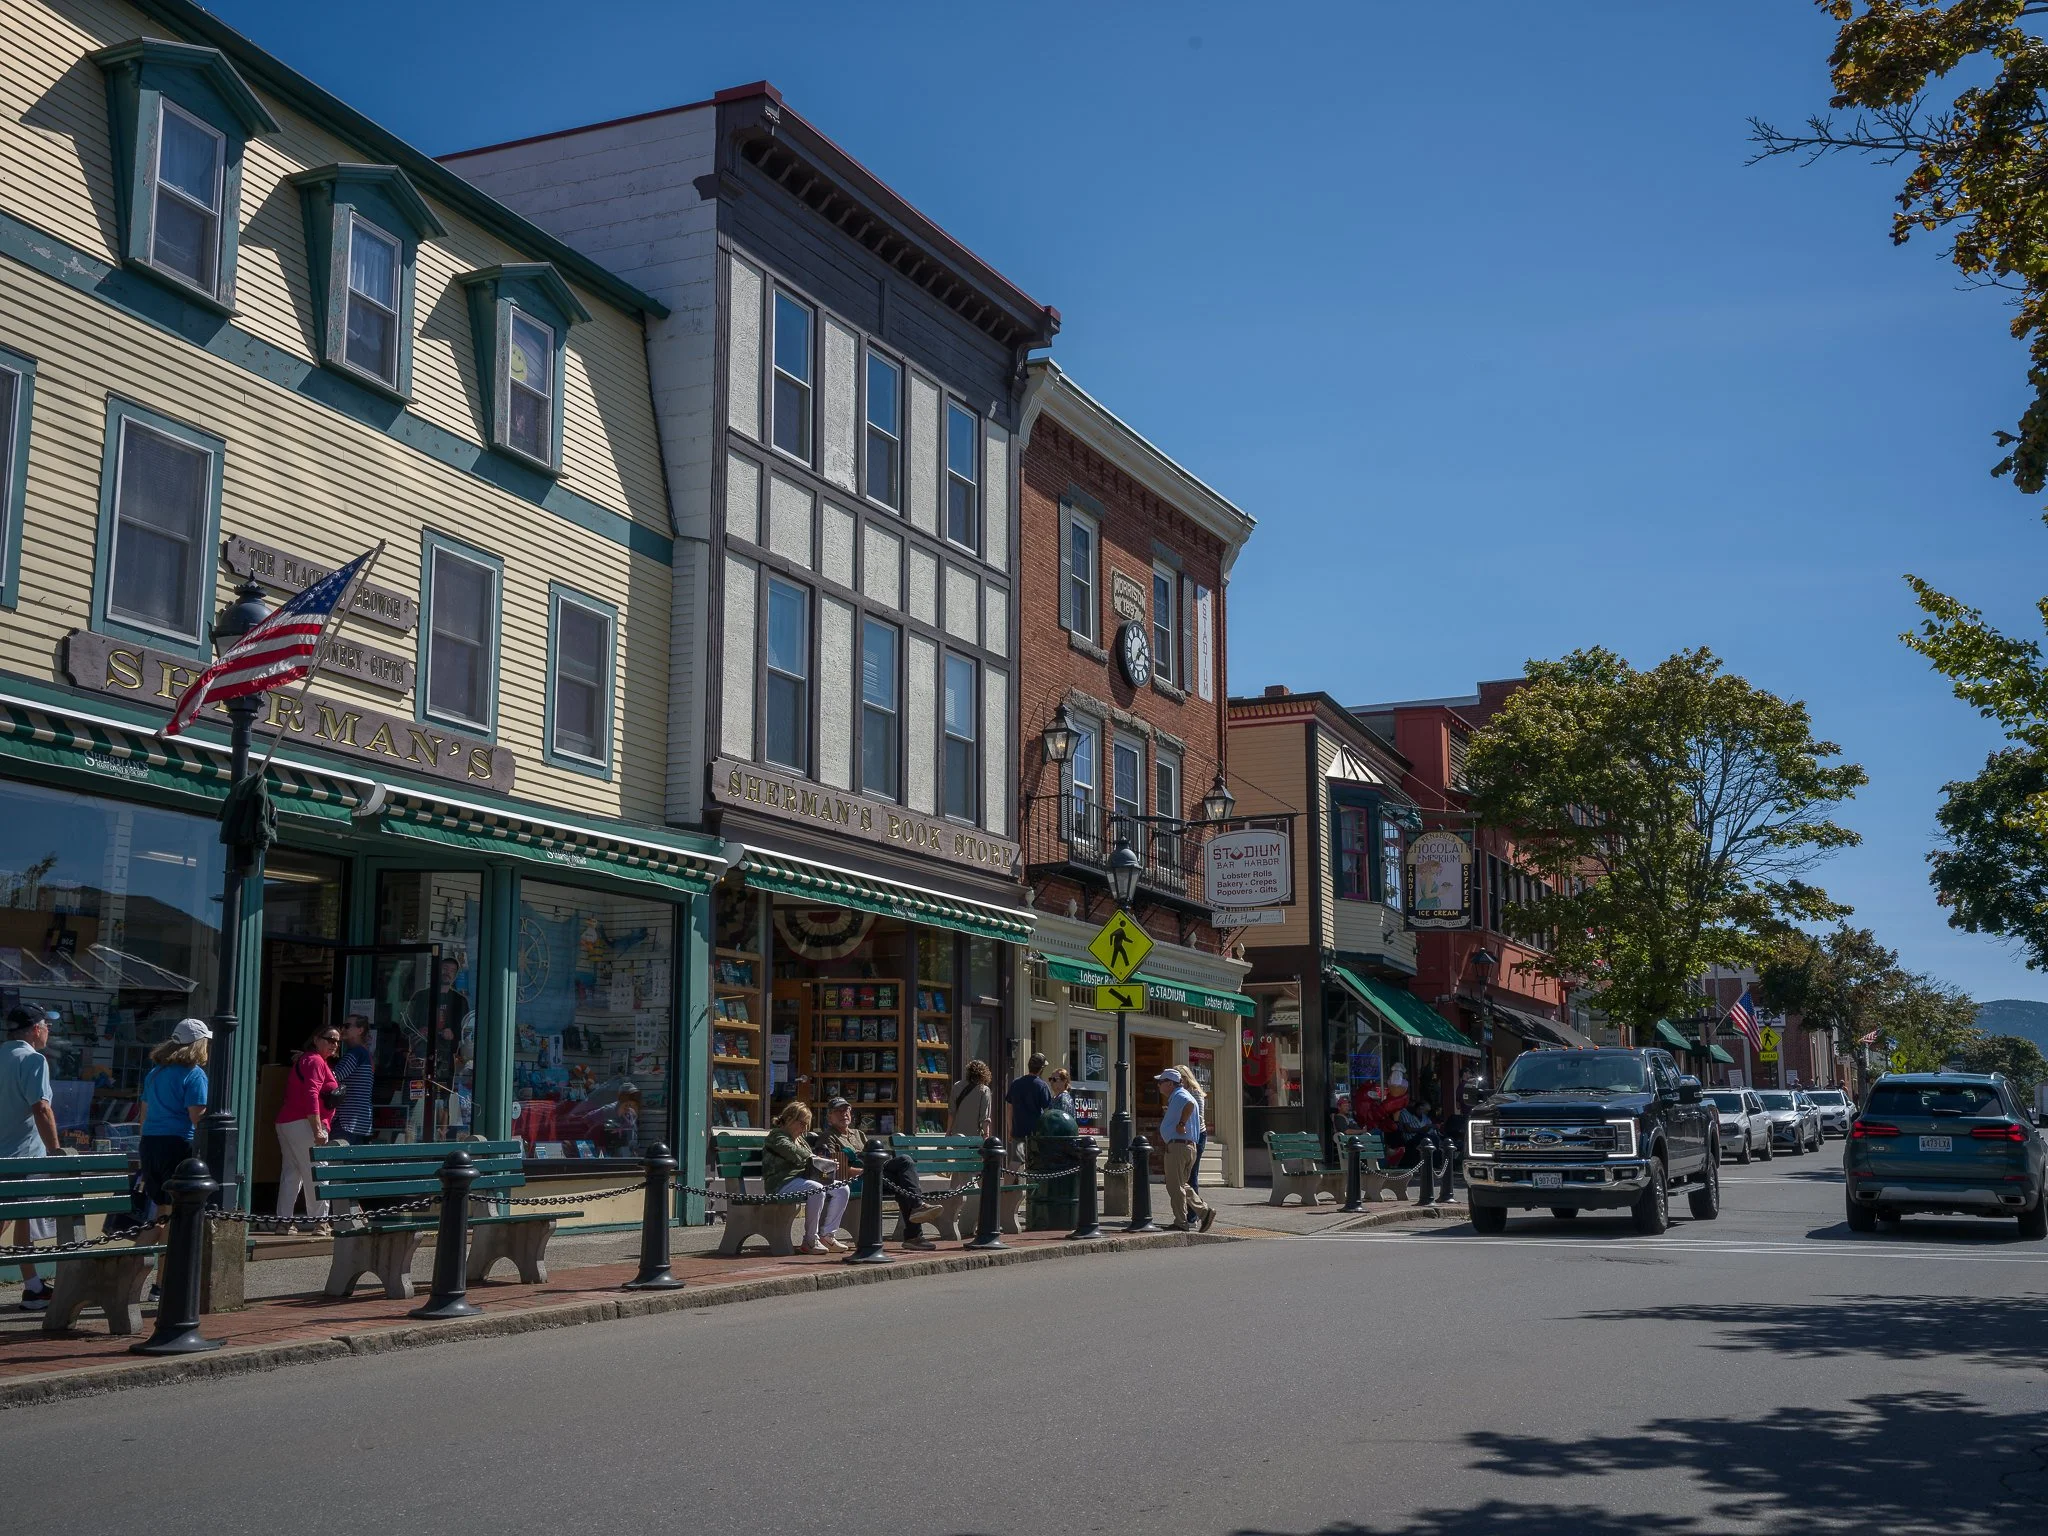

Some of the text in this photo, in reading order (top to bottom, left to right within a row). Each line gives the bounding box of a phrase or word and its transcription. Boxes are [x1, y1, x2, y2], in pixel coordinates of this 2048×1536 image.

[370, 655, 404, 685] GIFTS
[105, 649, 494, 781] SHRMAN'S
[84, 750, 150, 772] SHERMAN'S
[728, 770, 1013, 869] SHERMAN'S BOOK STORE
[1409, 843, 1470, 854] CHOCOLATE
[1216, 858, 1279, 869] BAR HARBOR
[1417, 854, 1460, 864] EMPORIUM
[1222, 872, 1250, 880] Lobster
[1216, 888, 1252, 896] Popovers
[1080, 970, 1104, 985] Lobster
[1155, 985, 1186, 1003] STADIUM
[1204, 995, 1235, 1011] Lobster Rolls
[1537, 1135, 1553, 1143] Ford
